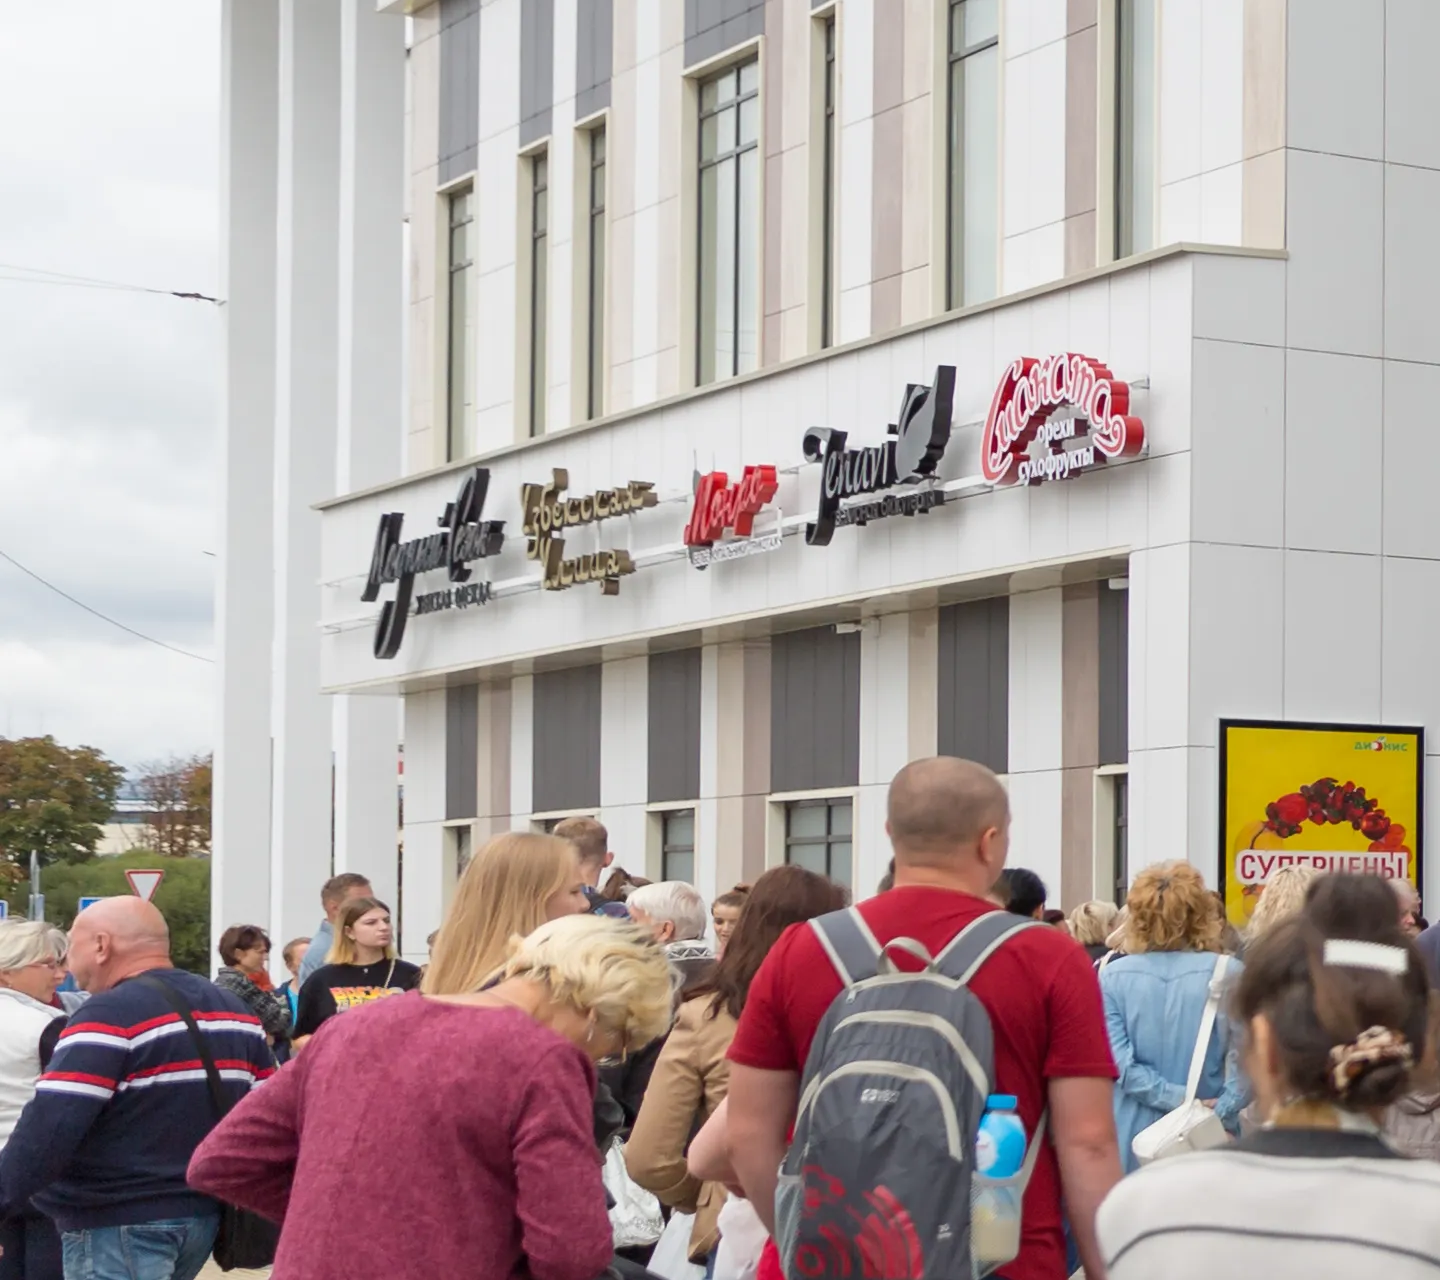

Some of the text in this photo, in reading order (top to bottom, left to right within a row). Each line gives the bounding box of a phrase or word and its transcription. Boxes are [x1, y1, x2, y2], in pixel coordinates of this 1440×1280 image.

[1037, 416, 1085, 448] орехи
[1018, 446, 1098, 486] сухофрукты
[520, 468, 657, 560] Узбекская
